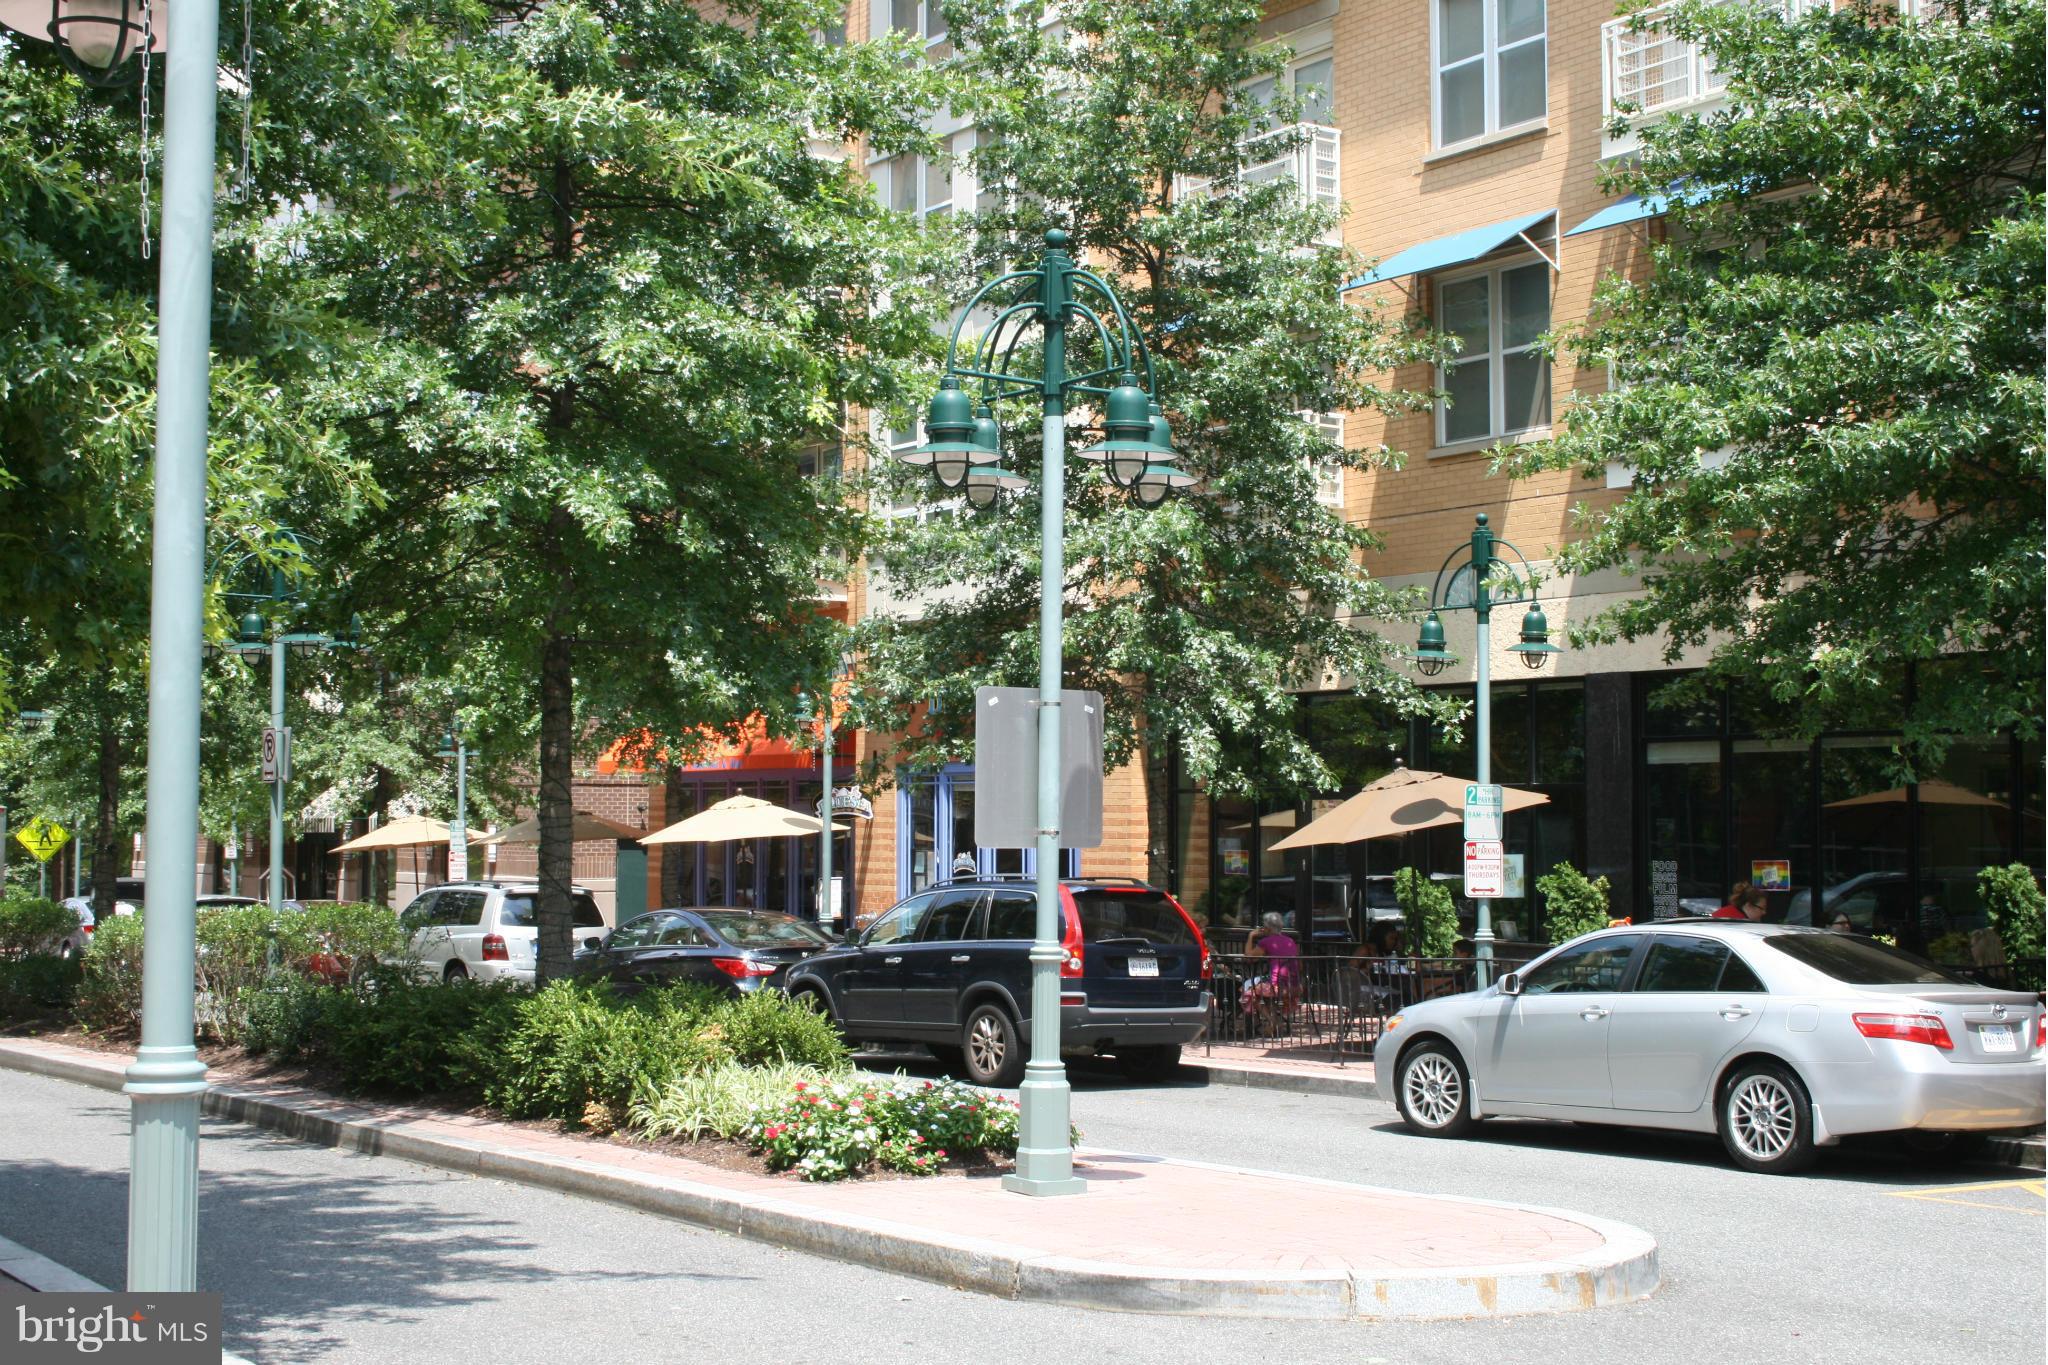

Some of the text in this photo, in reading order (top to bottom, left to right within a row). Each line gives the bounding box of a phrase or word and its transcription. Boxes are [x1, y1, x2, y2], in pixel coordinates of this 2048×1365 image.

[1468, 786, 1476, 804] 2
[1467, 845, 1476, 857] NO
[1653, 860, 1678, 871] FOOD
[1469, 871, 1500, 879] THURSDAYS
[1653, 883, 1678, 895] FILM
